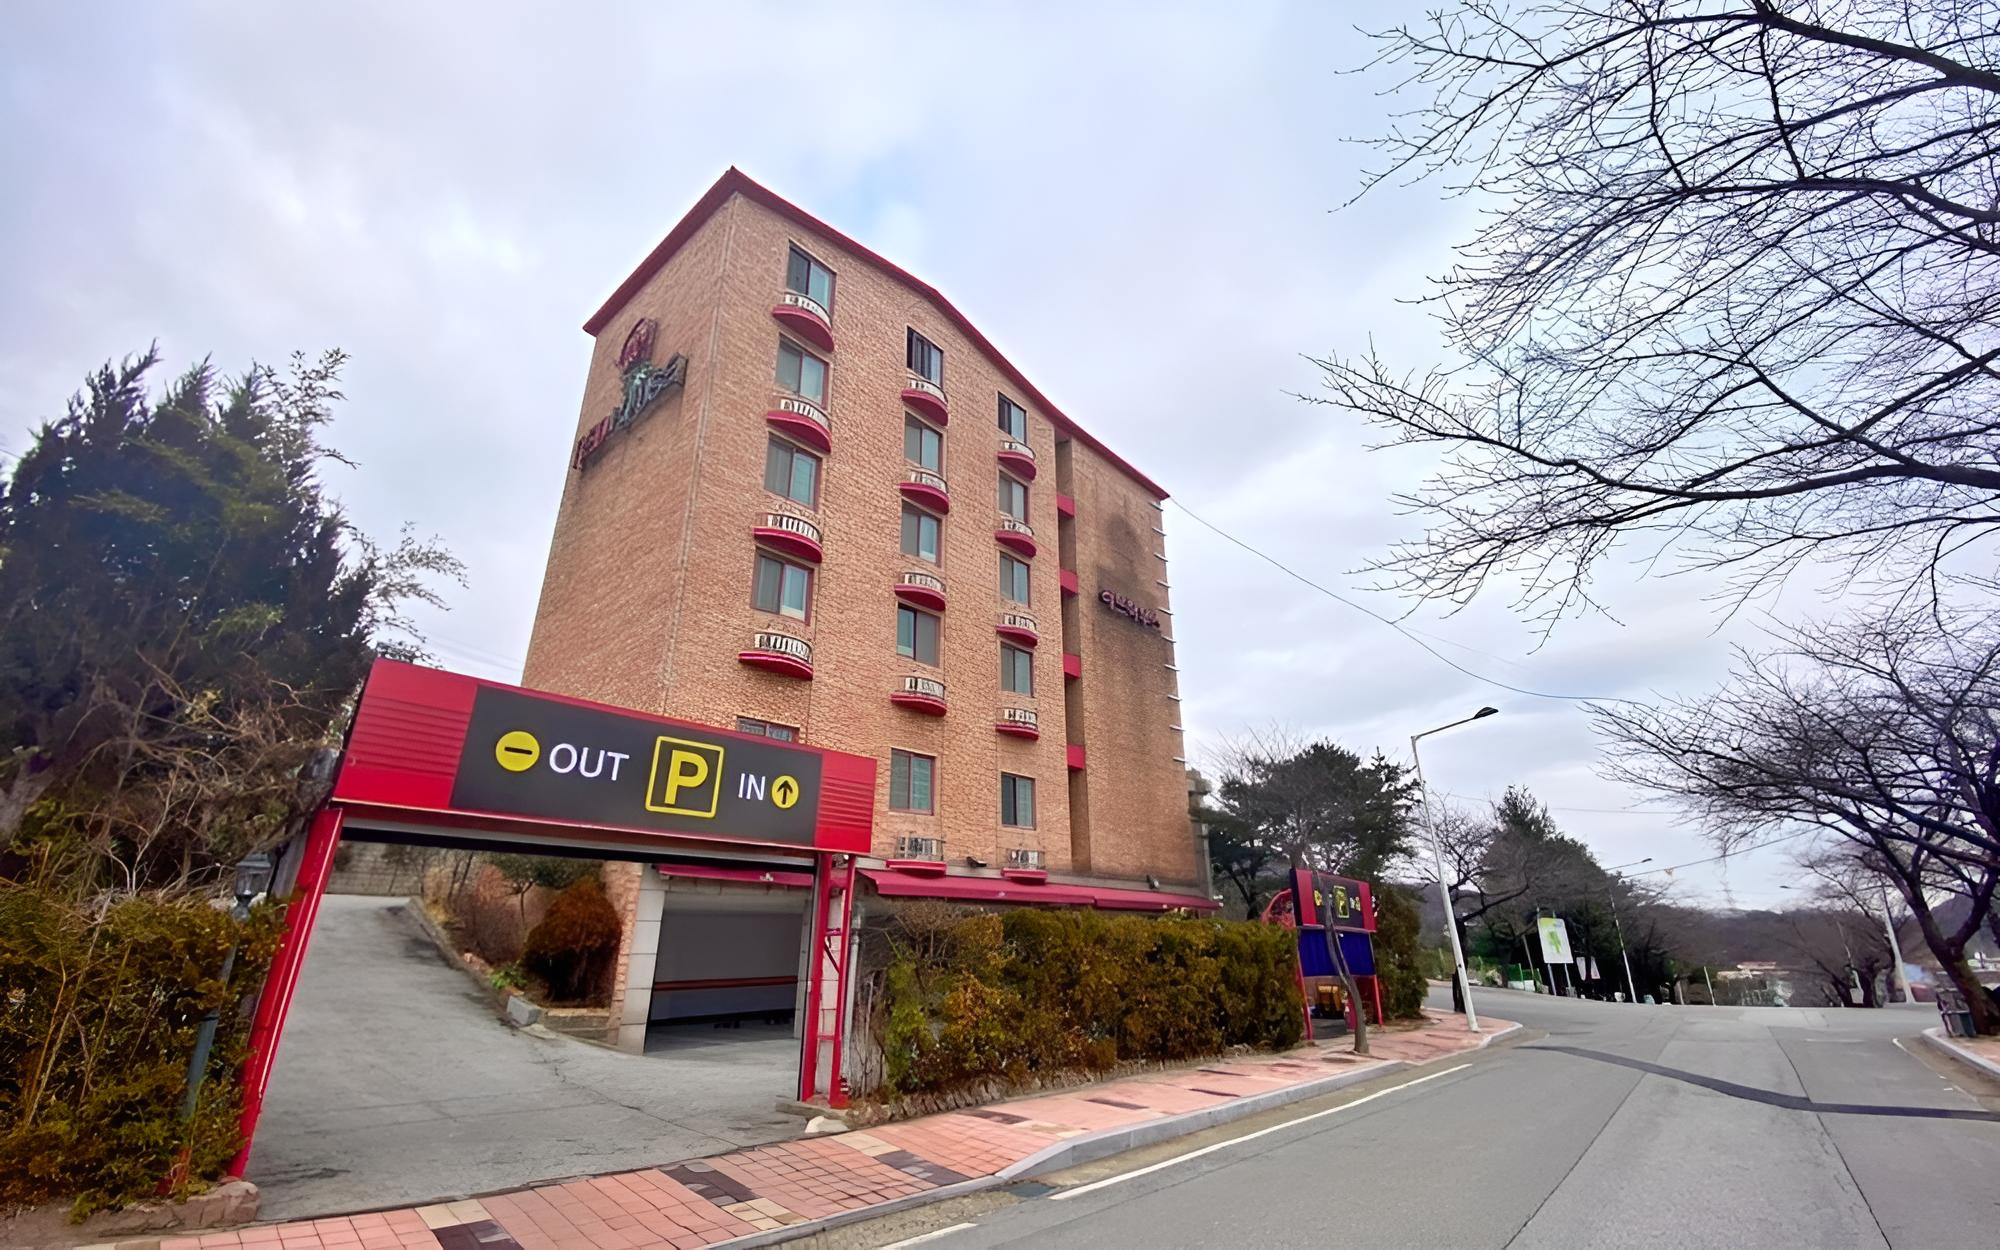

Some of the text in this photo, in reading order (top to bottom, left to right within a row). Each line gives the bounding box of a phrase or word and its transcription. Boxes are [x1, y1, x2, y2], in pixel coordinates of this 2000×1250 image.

[549, 743, 766, 805] OUT P IN
